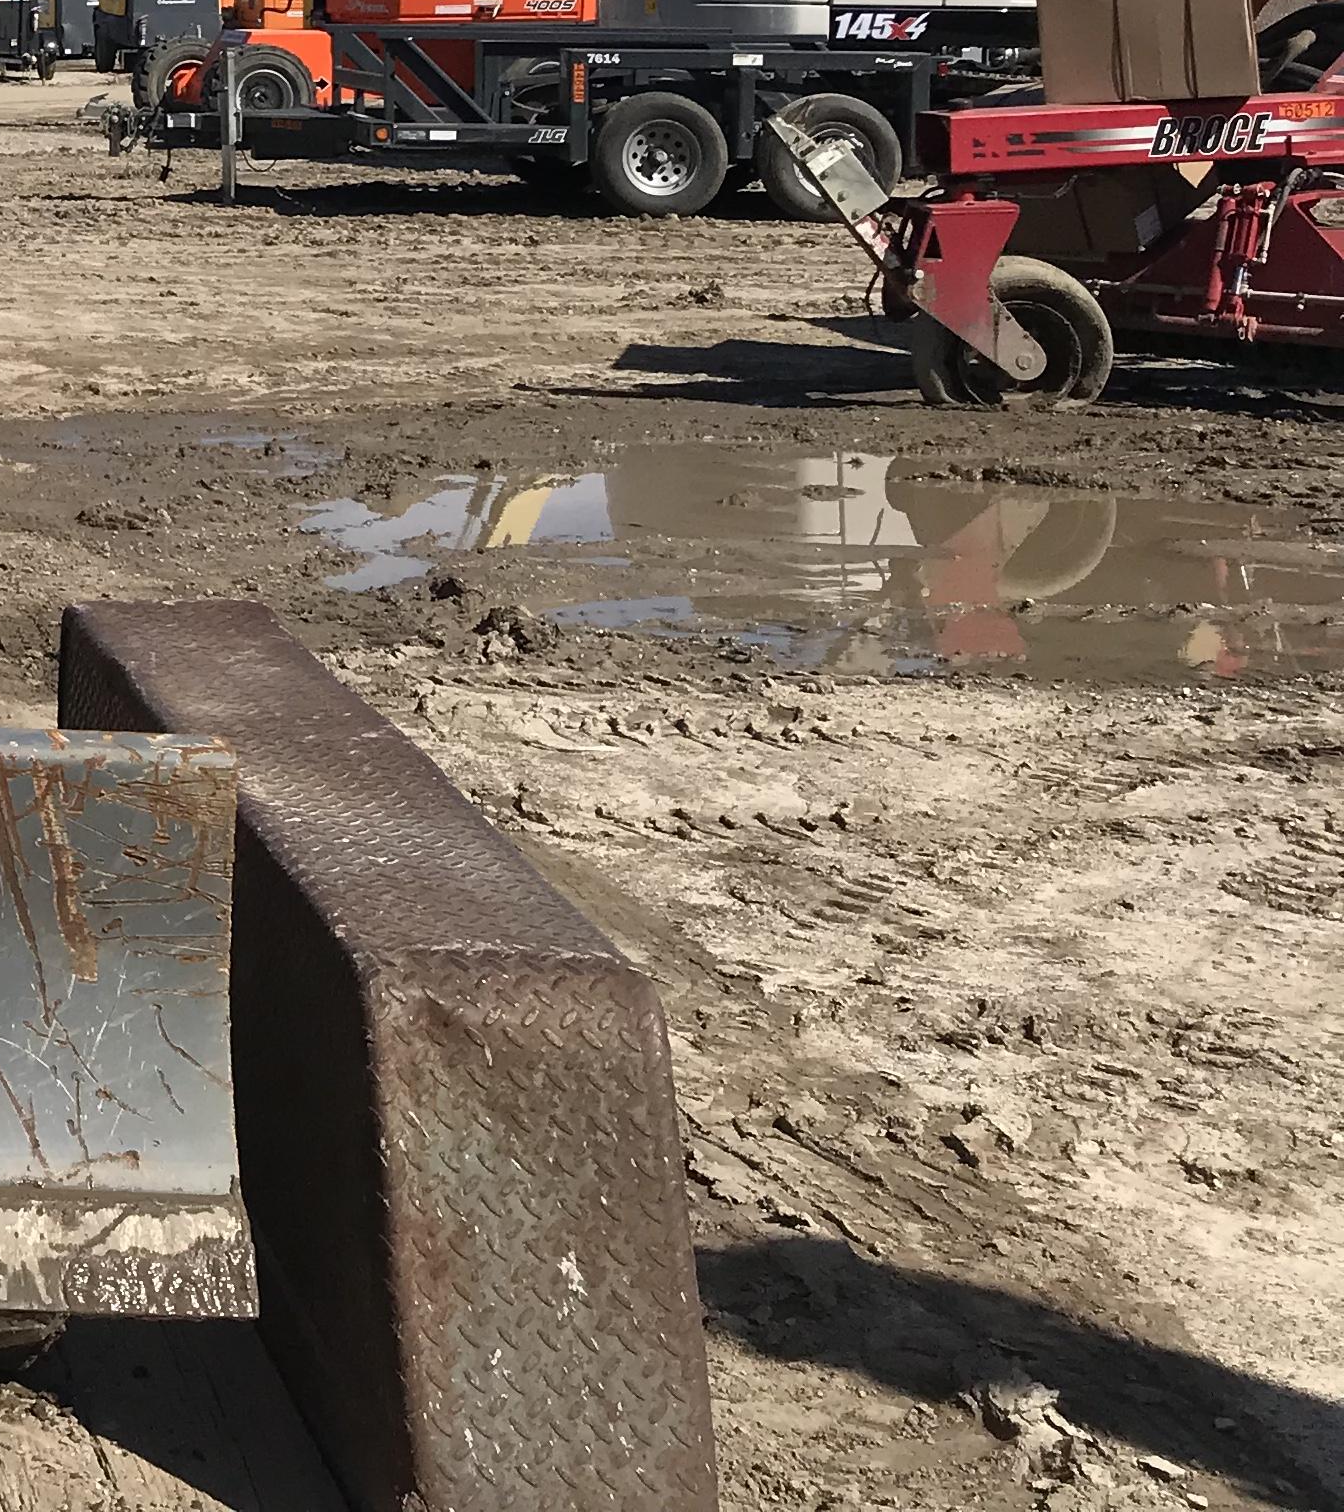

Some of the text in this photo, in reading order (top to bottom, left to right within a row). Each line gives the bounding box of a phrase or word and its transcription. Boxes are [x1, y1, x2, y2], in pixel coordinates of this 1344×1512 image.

[587, 53, 621, 64] 7614
[1285, 101, 1333, 118] 60512
[528, 128, 568, 144] JLG
[1148, 102, 1273, 158] BROCE
